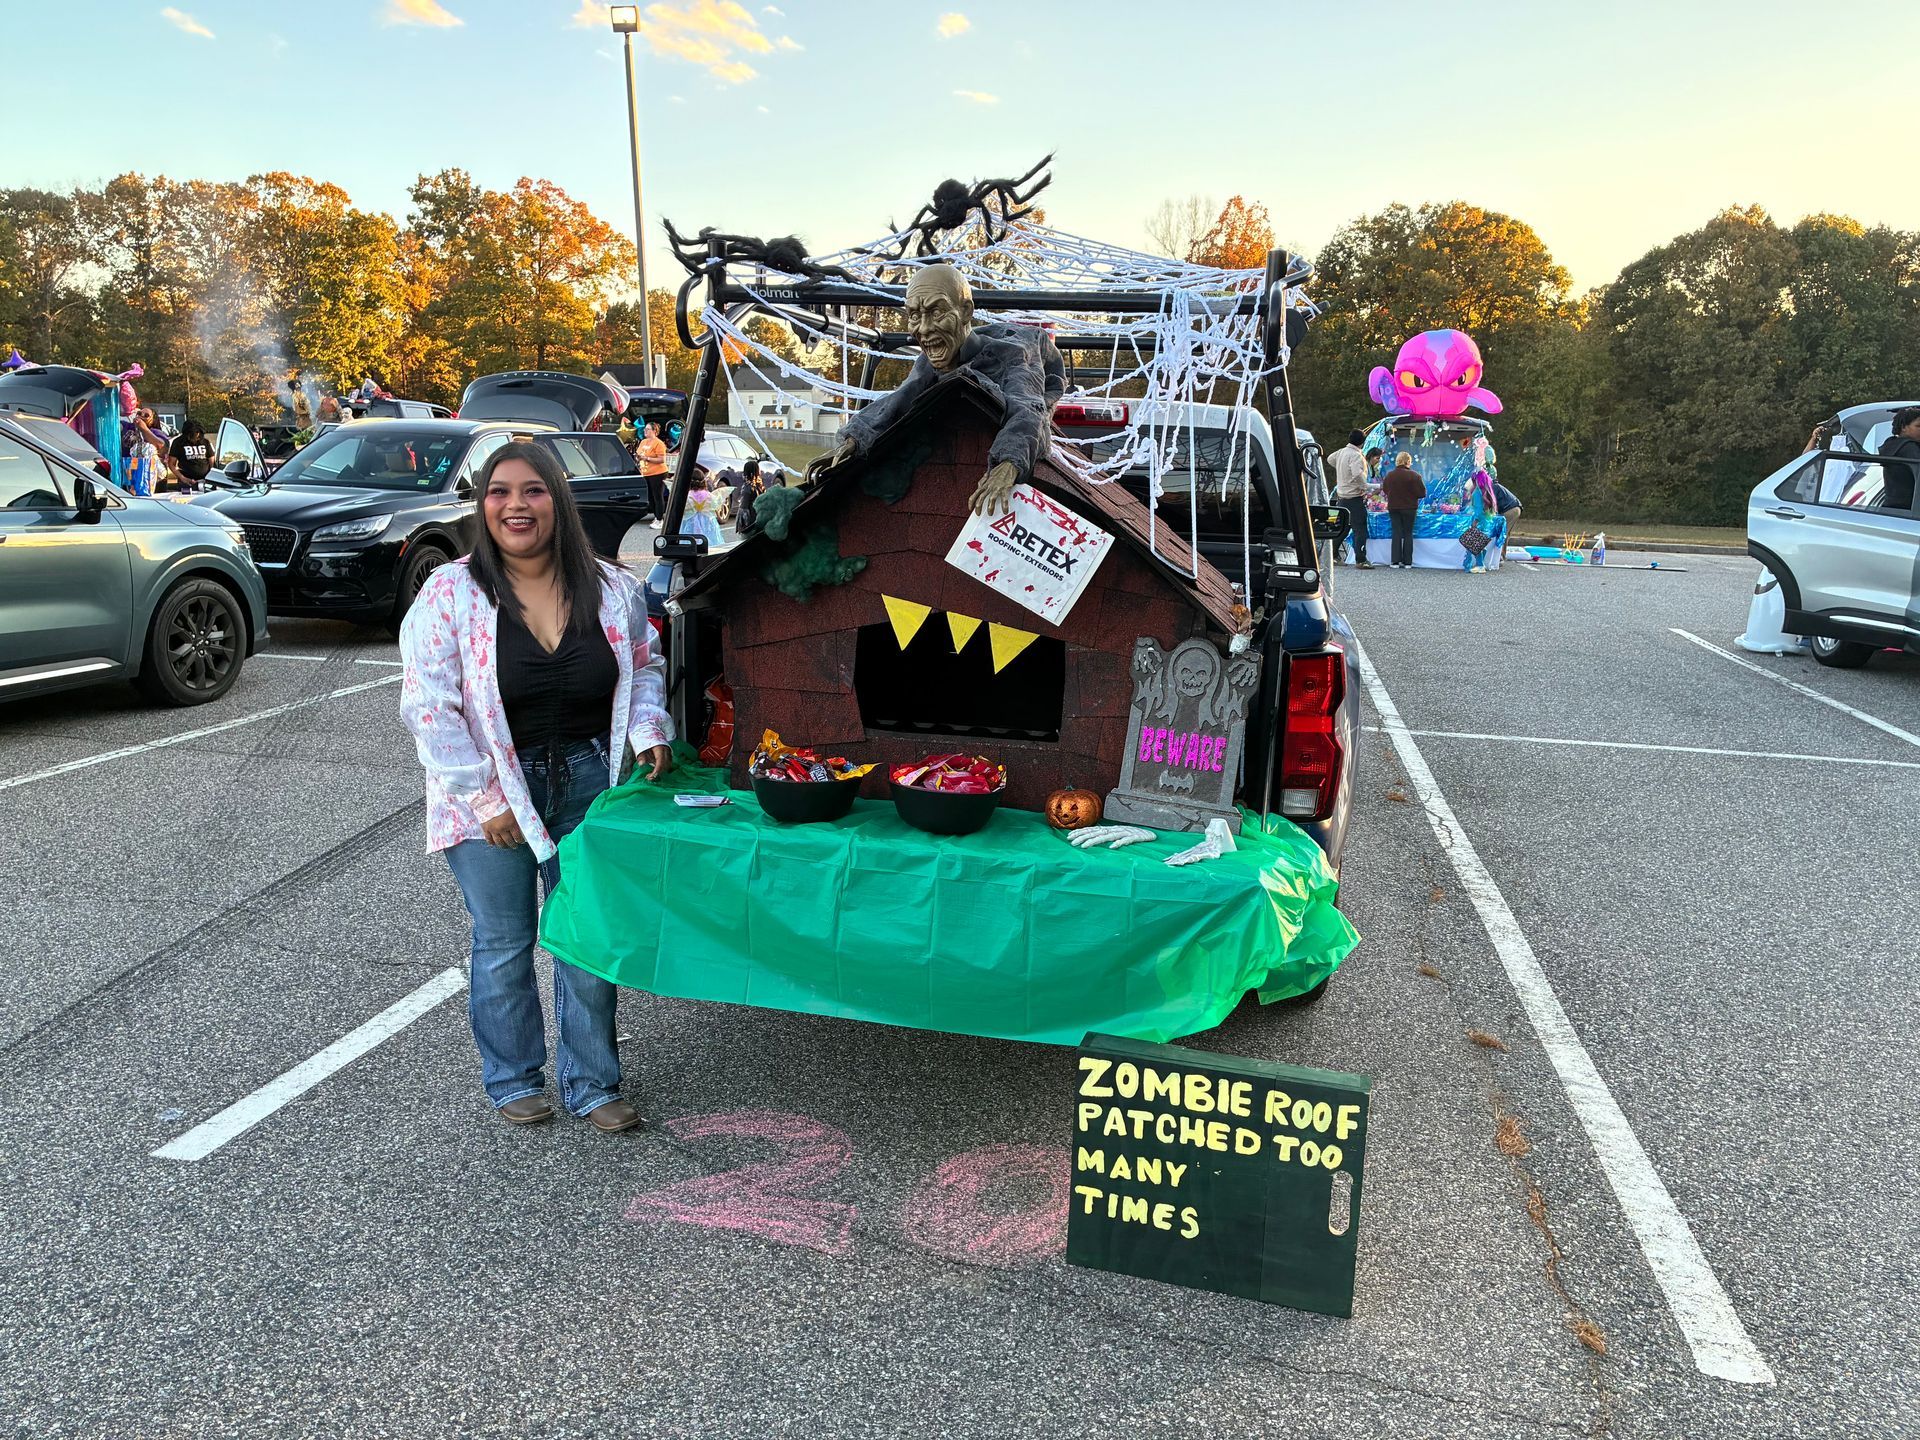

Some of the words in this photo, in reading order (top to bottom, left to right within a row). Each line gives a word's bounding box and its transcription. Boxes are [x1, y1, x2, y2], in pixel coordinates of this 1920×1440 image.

[183, 445, 206, 455] BIG
[987, 532, 1021, 557] ROOFING
[1024, 556, 1065, 582] EXTERIORS
[1139, 726, 1227, 773] BEWARE
[1078, 1056, 1254, 1118] ZOMBIE
[1264, 1089, 1361, 1140] ROOF
[1078, 1102, 1262, 1156] PATCHED
[1272, 1135, 1344, 1170] TOO
[1077, 1146, 1188, 1188] MANY
[1074, 1185, 1201, 1240] TIMES
